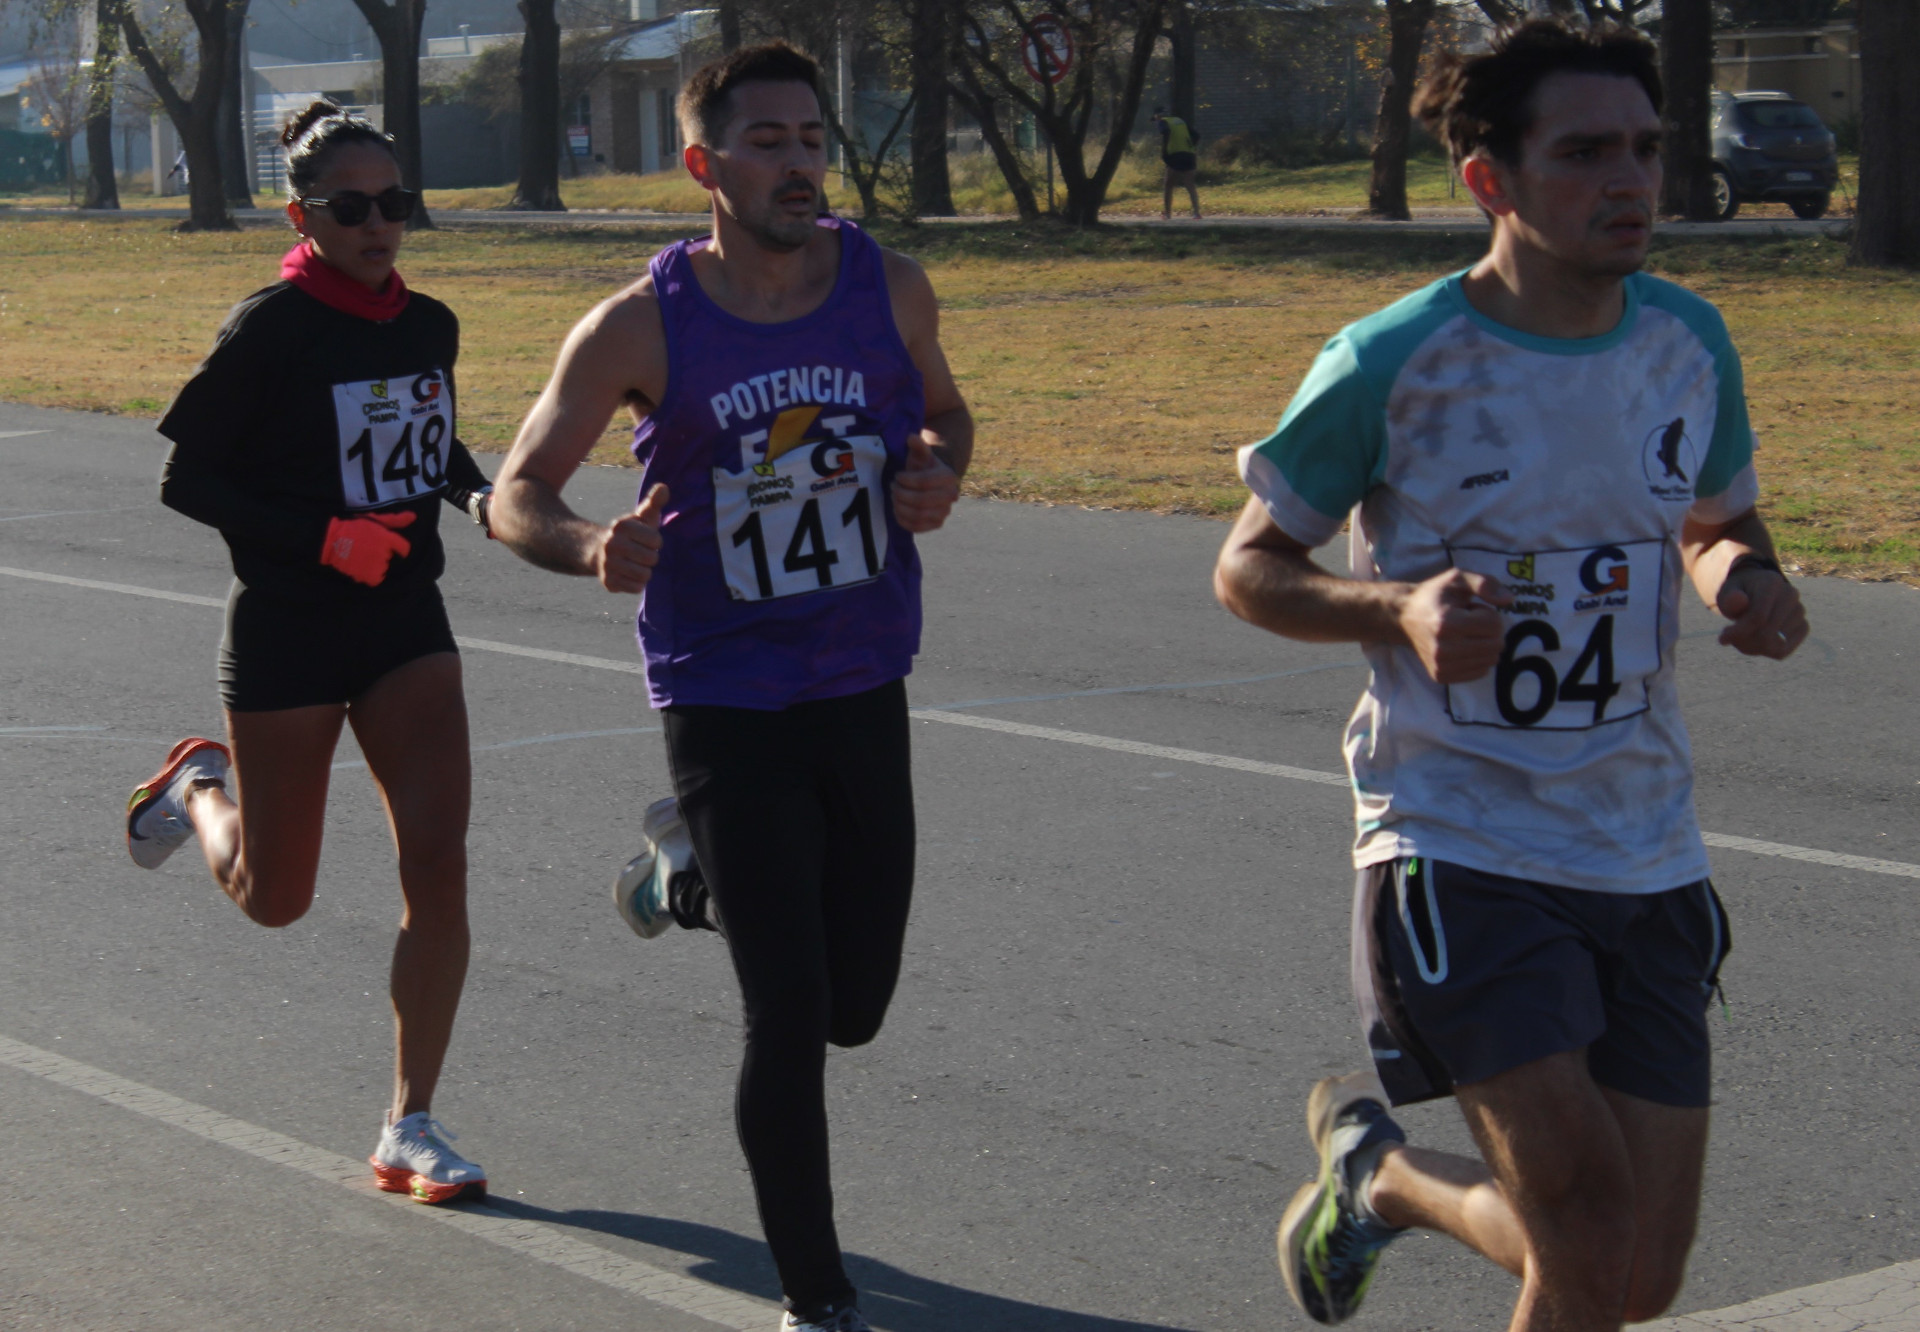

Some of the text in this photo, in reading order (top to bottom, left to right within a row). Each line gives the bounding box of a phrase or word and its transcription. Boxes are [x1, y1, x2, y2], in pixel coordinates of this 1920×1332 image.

[362, 398, 400, 416] CRONOS
[710, 366, 866, 430] POTENCIA
[368, 412, 400, 424] PAMPA
[347, 414, 446, 503] 148
[810, 480, 835, 492] Gabi
[836, 474, 859, 485] And
[750, 490, 793, 508] PAMPA
[732, 487, 879, 597] 141
[1505, 583, 1555, 601] ONOS
[1496, 600, 1550, 616] AMPA
[1573, 594, 1628, 611] Gabi And
[1496, 614, 1621, 726] 64
